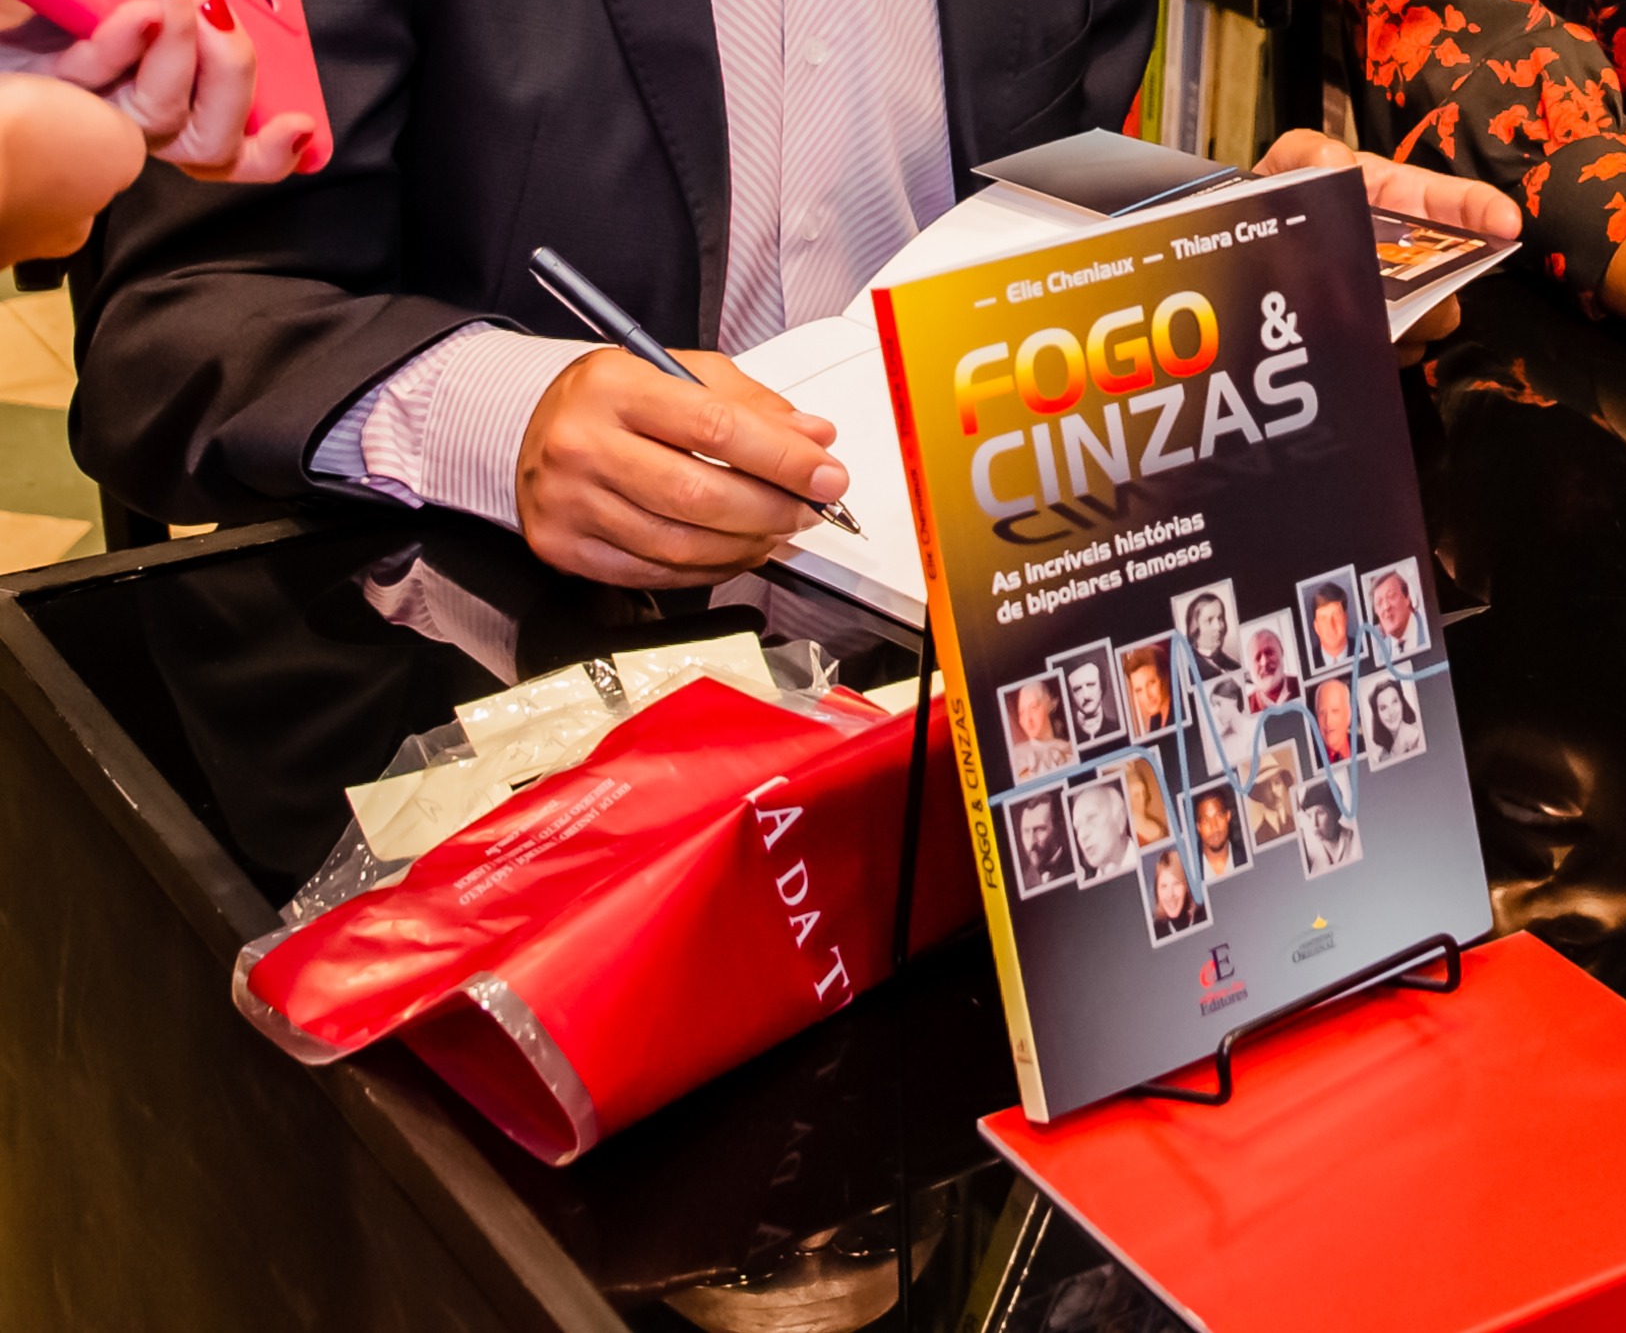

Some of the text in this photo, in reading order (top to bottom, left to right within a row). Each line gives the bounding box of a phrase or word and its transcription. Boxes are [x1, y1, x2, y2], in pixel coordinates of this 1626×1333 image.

[1005, 215, 1279, 304] Elie Cheniaux Thiara Cruz
[953, 290, 1303, 436] FOGO &
[969, 347, 1319, 519] CINZAS
[991, 510, 1206, 595] As incríveis histórias
[996, 540, 1214, 625] de bipolares famosos
[564, 775, 617, 816] RIBEIRÃO
[609, 781, 633, 801] RIO
[946, 696, 1002, 890] FOGO & CINZAS
[535, 811, 573, 841] PRETO
[555, 805, 601, 842] JANEIRO
[452, 861, 491, 891] LISBOA
[1200, 988, 1248, 1016] Editores
